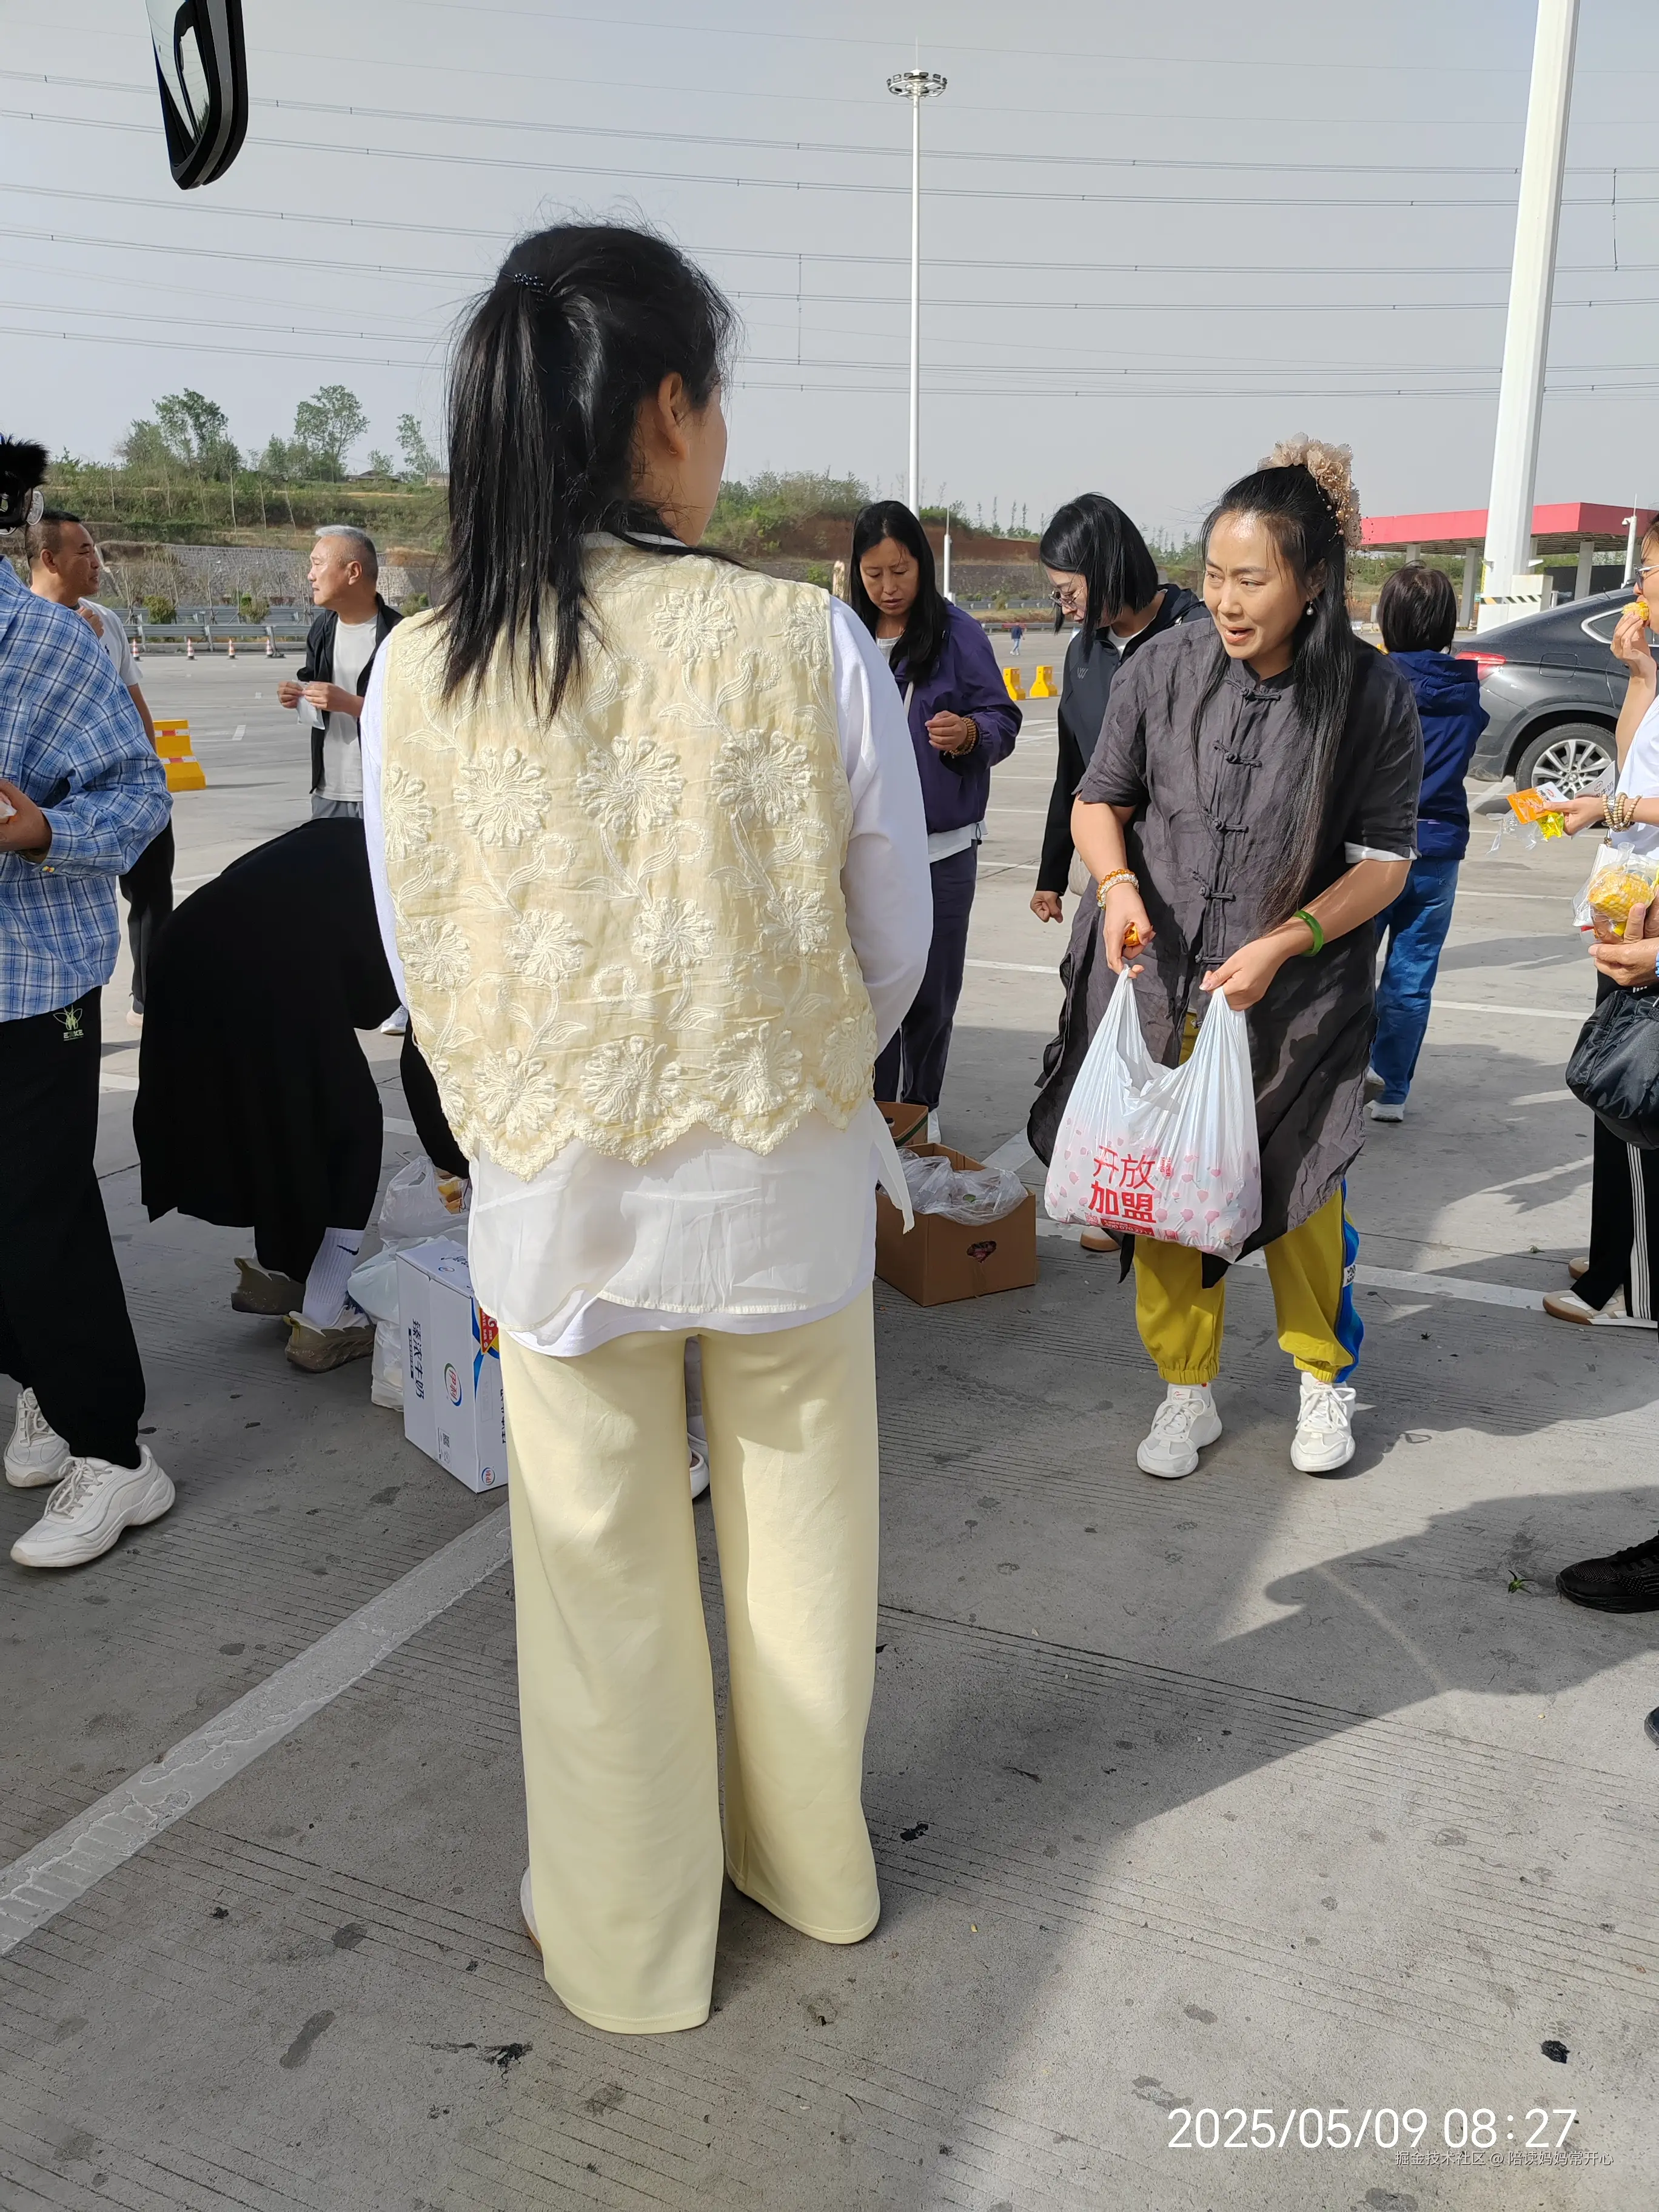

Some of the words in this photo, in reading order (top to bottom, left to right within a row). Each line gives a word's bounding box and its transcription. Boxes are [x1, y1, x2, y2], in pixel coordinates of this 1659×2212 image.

[1093, 1145, 1156, 1191] 开放
[1088, 1180, 1157, 1224] 加盟
[449, 1369, 458, 1401] 伊利
